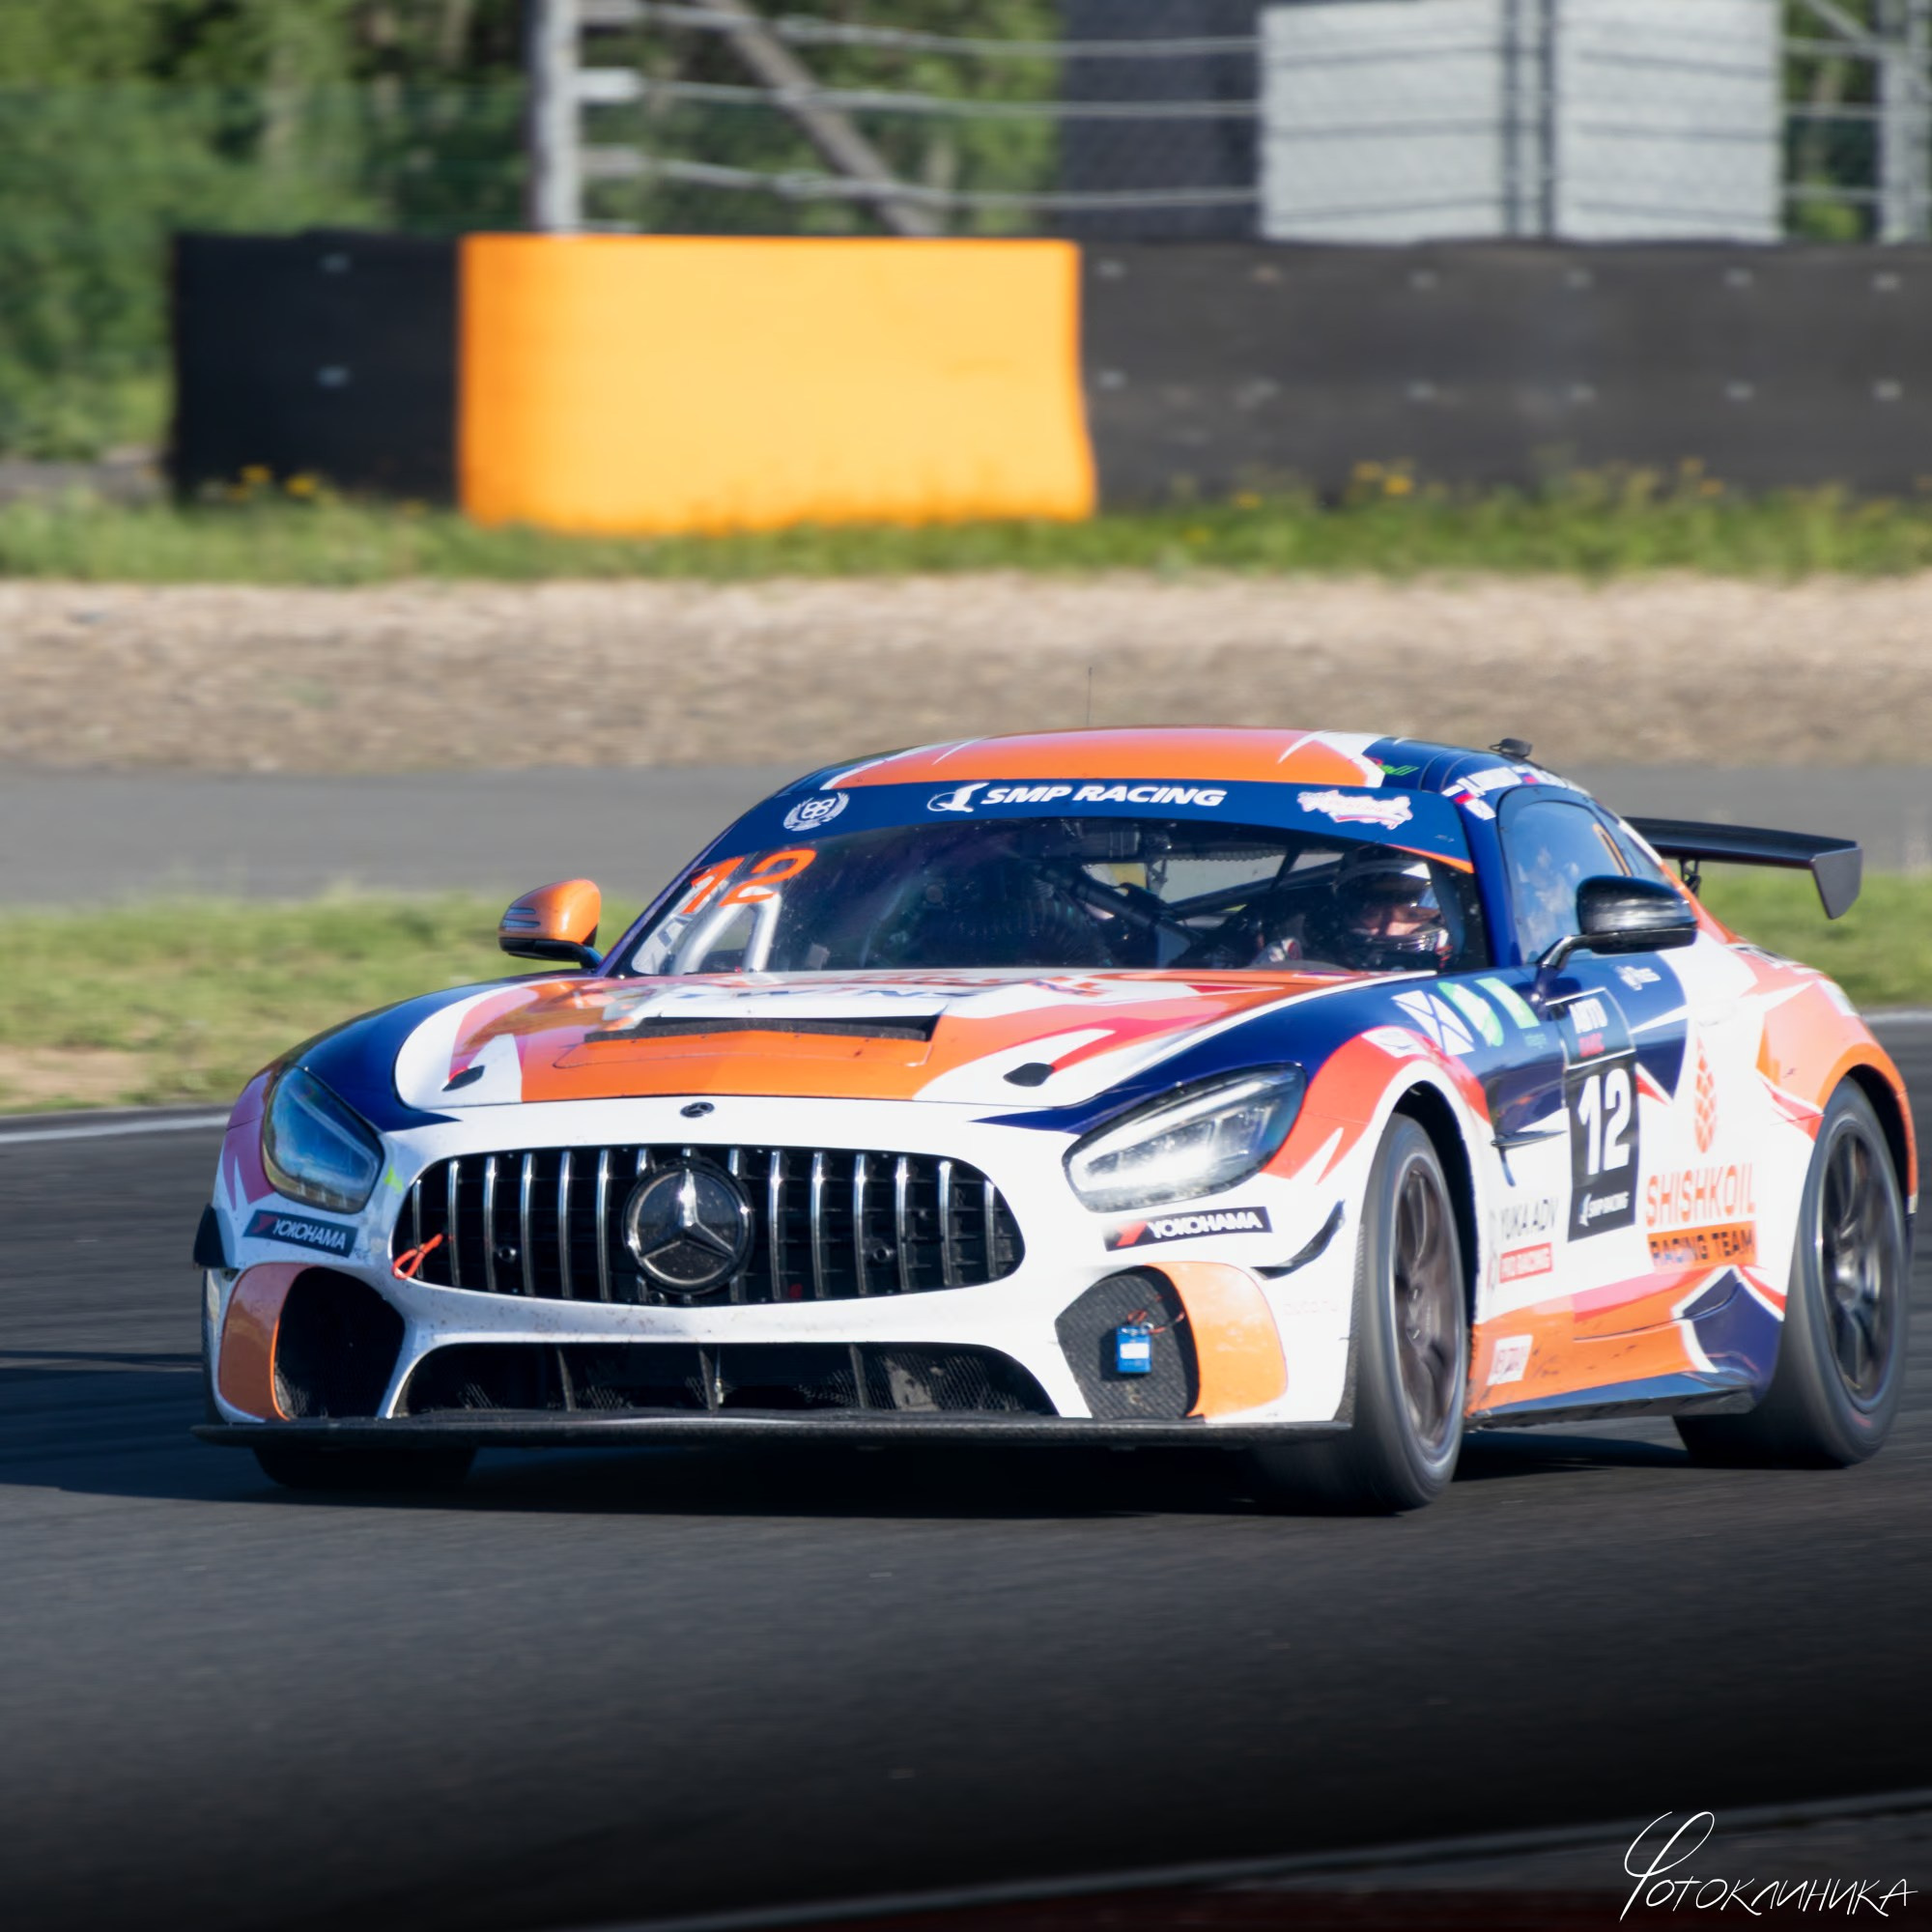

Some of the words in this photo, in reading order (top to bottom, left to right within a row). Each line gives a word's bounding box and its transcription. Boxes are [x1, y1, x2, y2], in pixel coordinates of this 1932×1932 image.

[980, 785, 1073, 805] SMP
[1072, 785, 1228, 807] RACING
[681, 849, 817, 915] 12
[1577, 1067, 1632, 1176] 12
[1645, 1162, 1755, 1227] SHISHKOIL
[271, 1218, 348, 1250] YOKOHAMA
[1147, 1211, 1264, 1238] YOKOHAMA
[1711, 1229, 1753, 1258] TEAM
